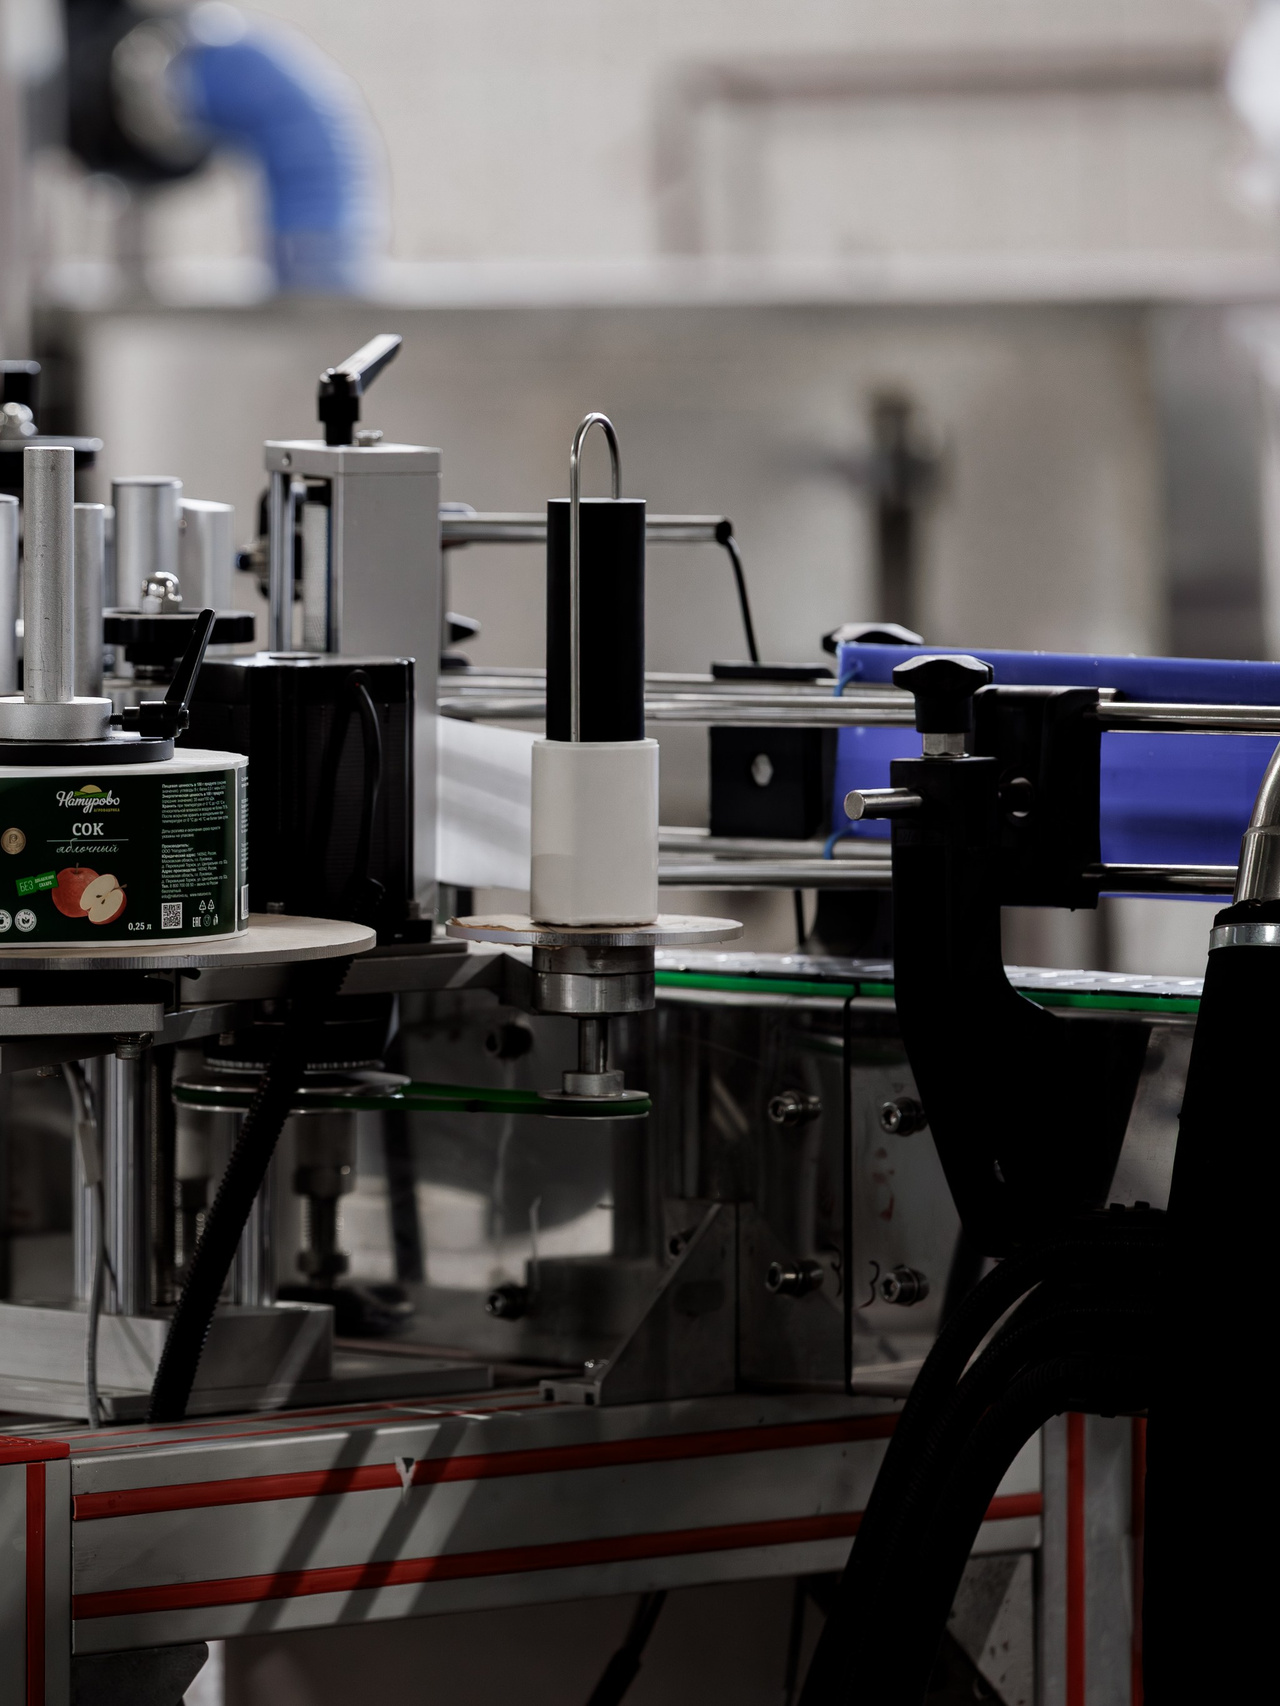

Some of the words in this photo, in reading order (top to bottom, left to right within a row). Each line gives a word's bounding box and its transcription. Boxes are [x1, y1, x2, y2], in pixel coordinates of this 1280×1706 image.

[56, 790, 120, 814] Натурово
[72, 822, 104, 836] СОК
[56, 838, 119, 853] яблочный
[19, 880, 34, 892] БЕЗ
[128, 922, 145, 931] 0,25
